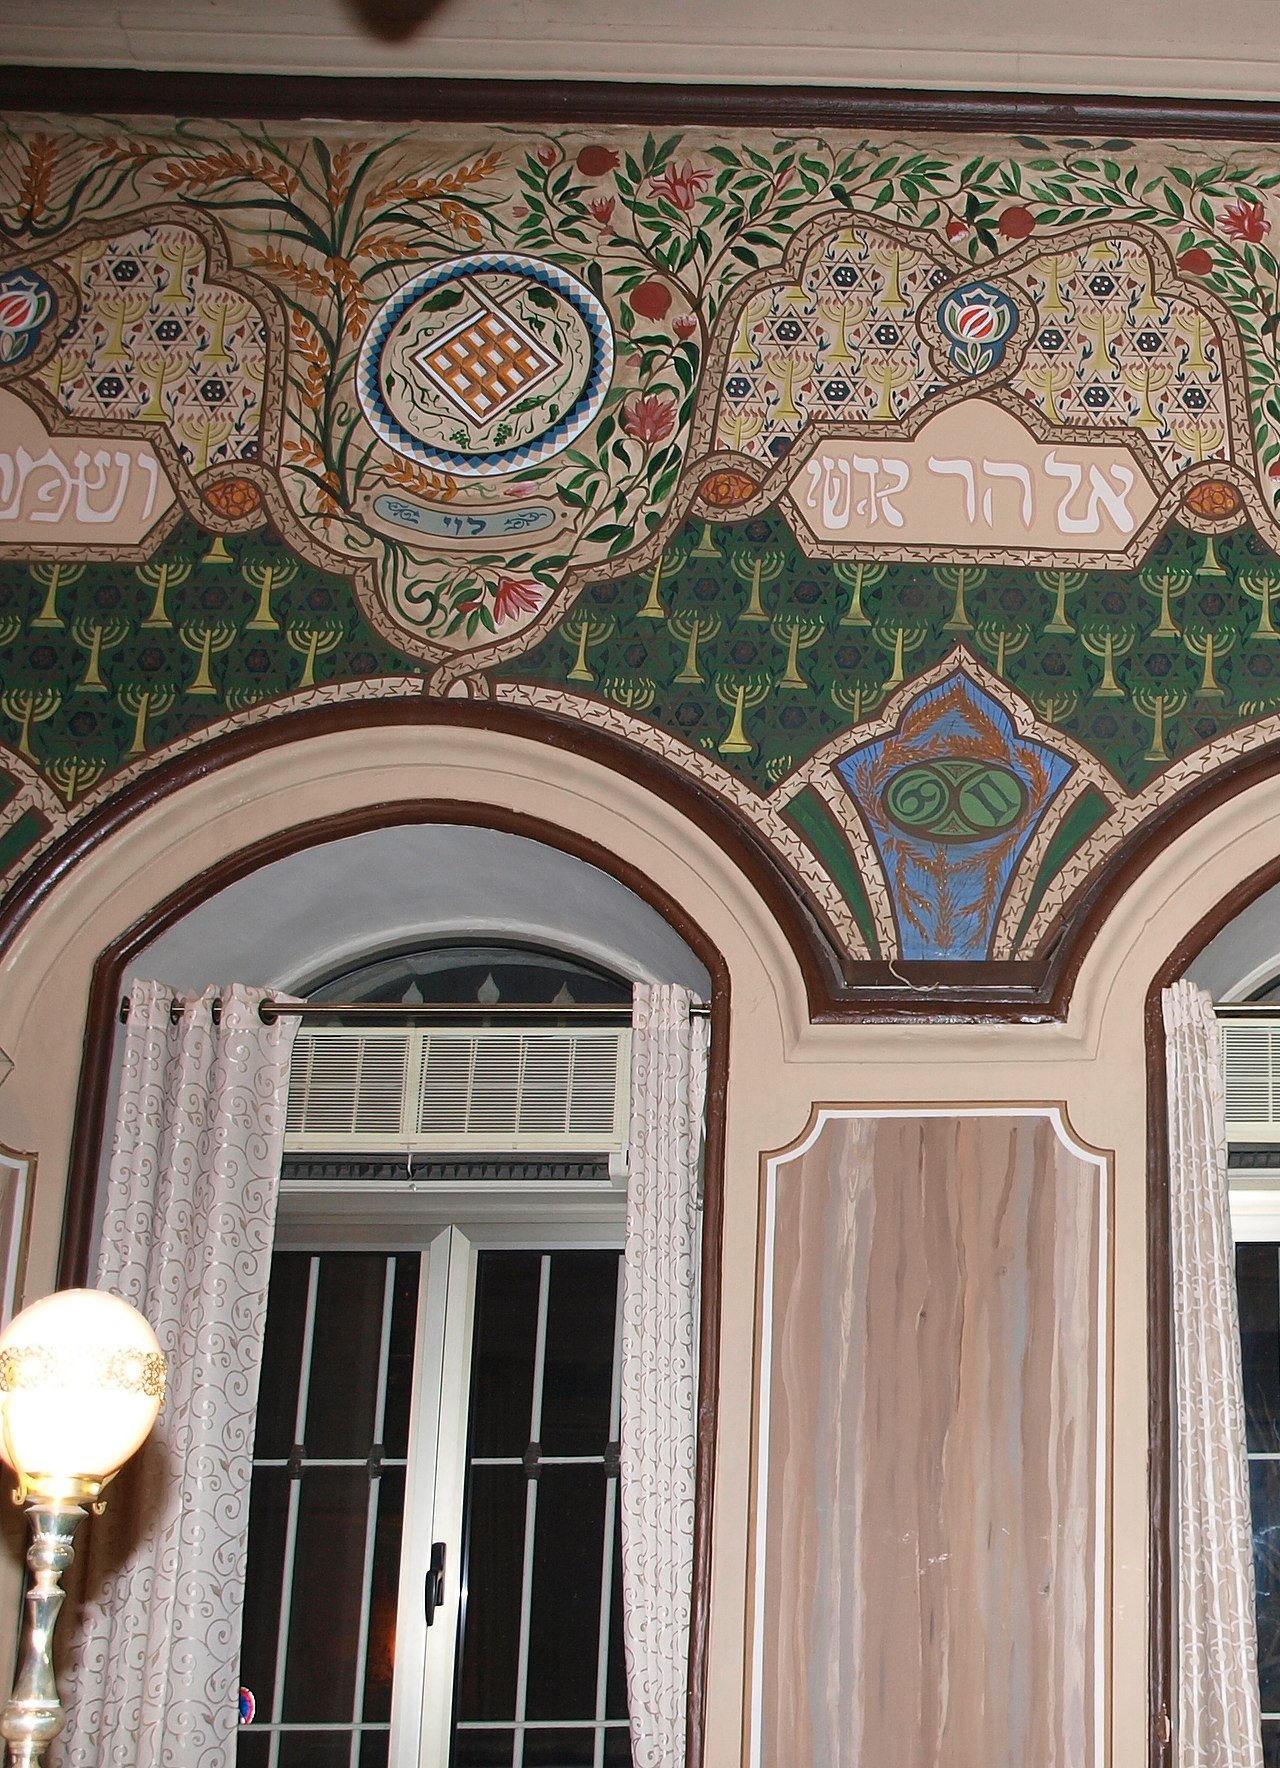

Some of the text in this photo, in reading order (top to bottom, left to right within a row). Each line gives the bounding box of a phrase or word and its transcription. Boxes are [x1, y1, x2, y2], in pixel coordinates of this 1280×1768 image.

[806, 451, 1135, 533] אל הר קדשי
[443, 516, 488, 536] לוי
